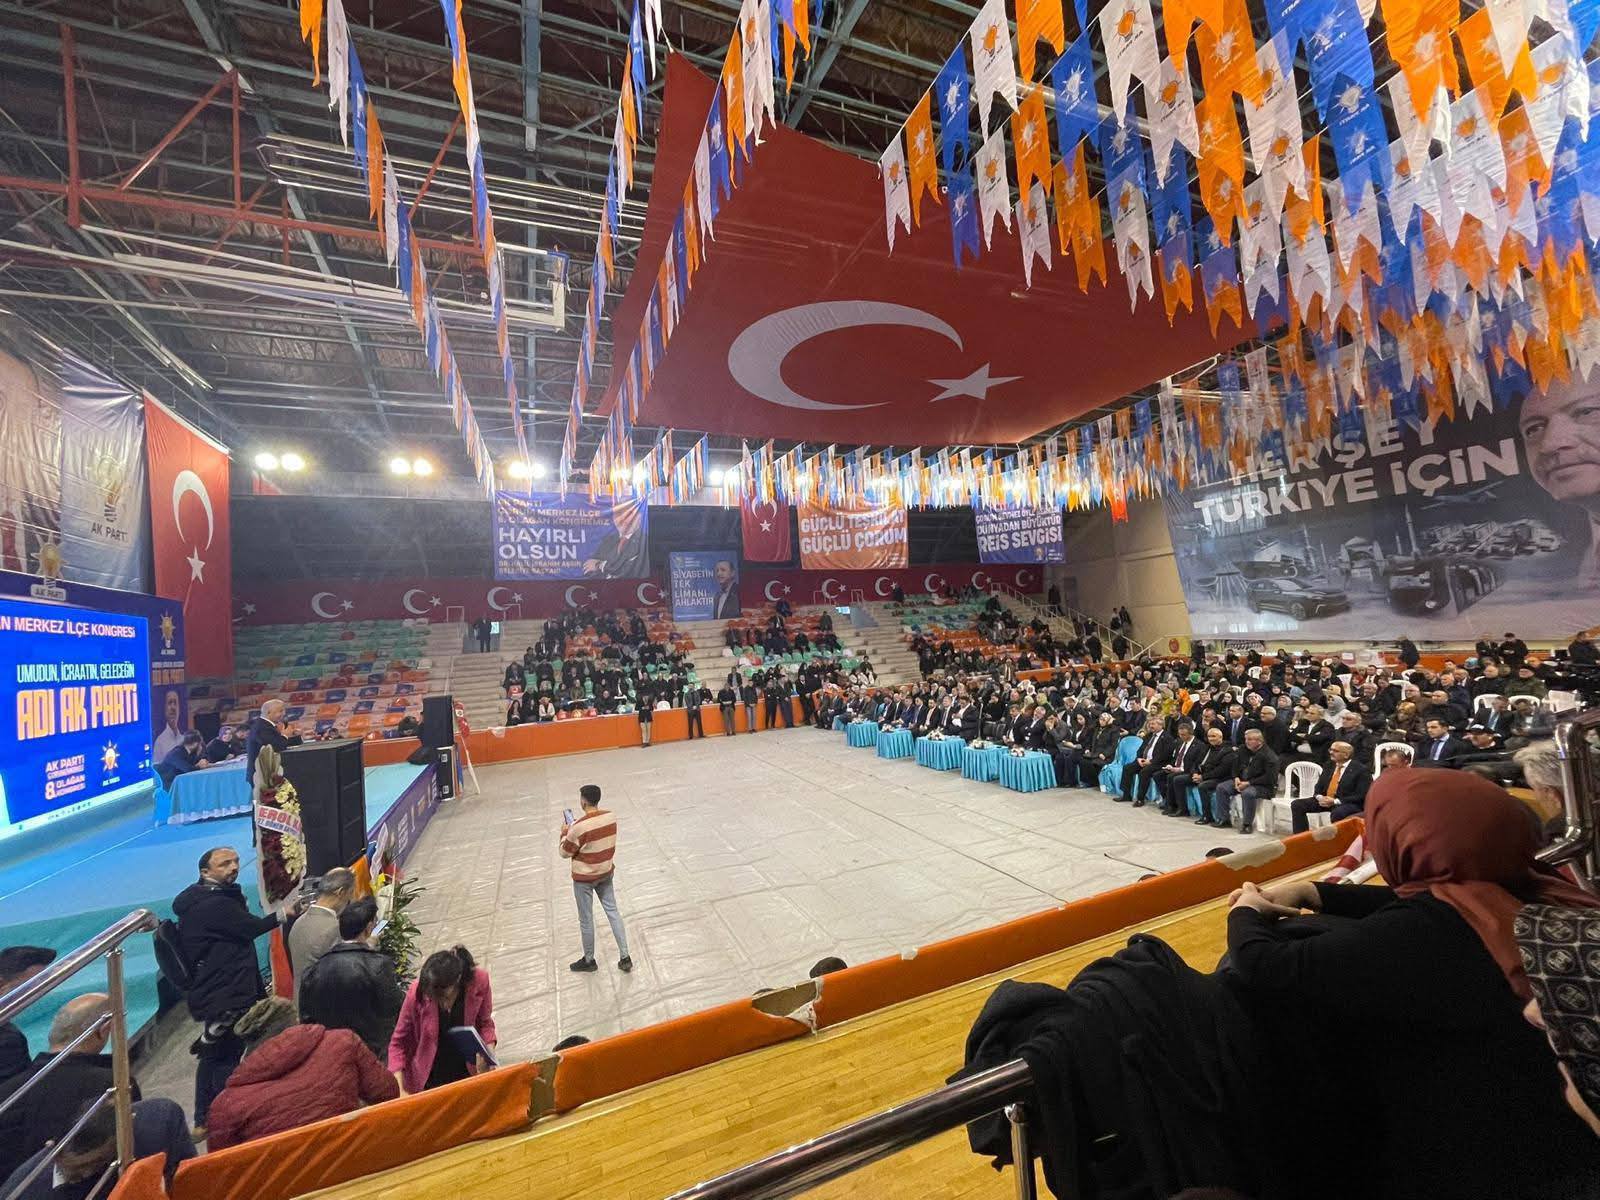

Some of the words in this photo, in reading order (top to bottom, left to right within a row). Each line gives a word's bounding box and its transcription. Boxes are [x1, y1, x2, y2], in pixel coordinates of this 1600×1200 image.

[1390, 438, 1520, 497] İÇİN
[91, 521, 103, 536] AK
[801, 512, 845, 535] GÜÇLÜ
[976, 520, 1020, 535] DÜNYADAN
[1021, 513, 1061, 529] BÜYÜKTÜR
[499, 527, 586, 544] HAYIRLI
[801, 529, 852, 556] GÜÇLÜ
[855, 527, 907, 552] ÇORUM
[978, 533, 1010, 553] REİS
[1011, 525, 1063, 549] SEVGİSİ
[499, 543, 577, 560] OLSUN
[674, 580, 691, 588] TEK
[676, 597, 714, 607] AHLAKTIR
[14, 617, 65, 634] MERKEZ
[66, 619, 90, 638] İLÇE
[91, 623, 136, 638] KONGRESİ
[17, 664, 60, 683] UMUDUN,
[60, 661, 100, 681] İCRAATIN,
[17, 688, 56, 741] ADI
[60, 686, 87, 734] AK
[90, 683, 139, 729] PARTİ
[45, 760, 59, 773] AK
[60, 754, 85, 769] PARTİ
